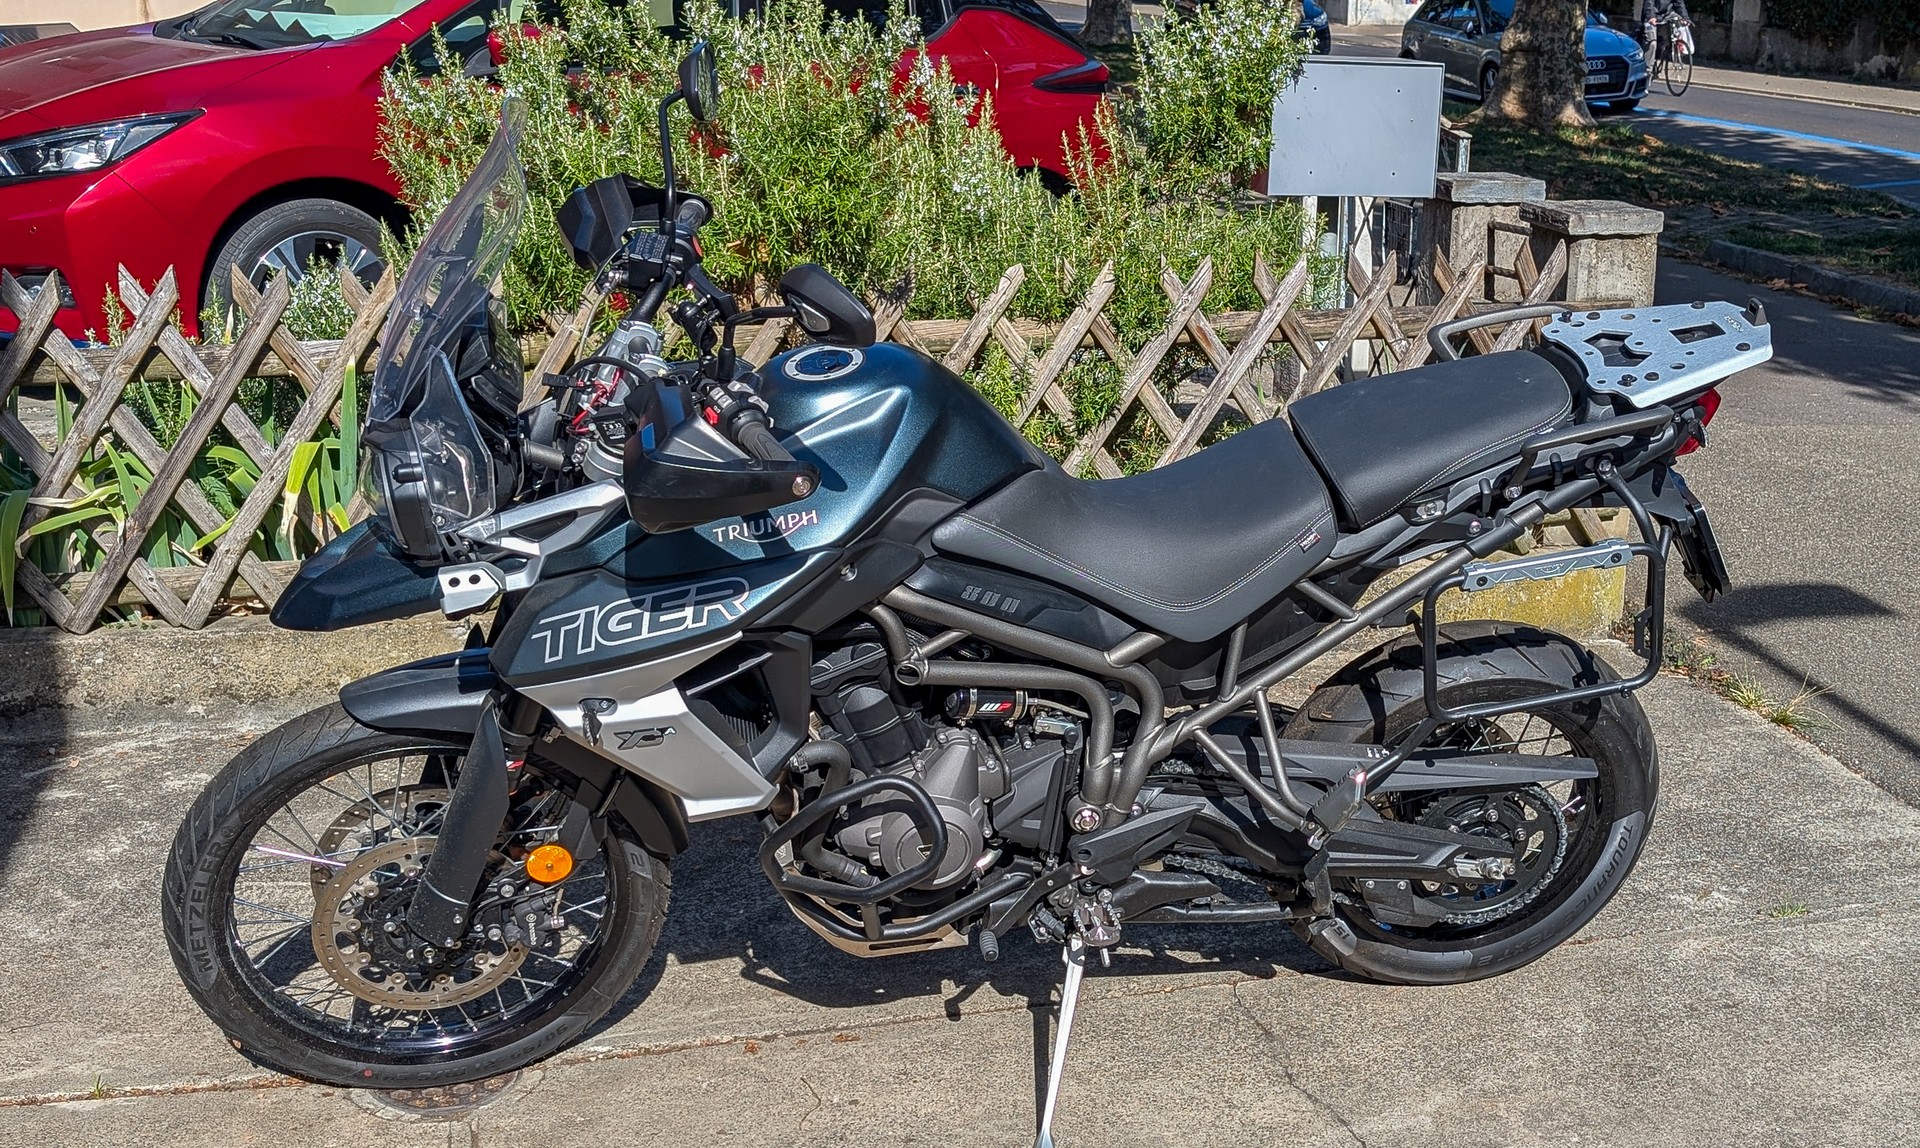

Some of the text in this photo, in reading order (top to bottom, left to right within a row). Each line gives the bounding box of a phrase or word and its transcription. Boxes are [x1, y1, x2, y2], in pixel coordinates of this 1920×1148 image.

[712, 510, 818, 543] TRIUMPH
[531, 577, 750, 663] TIGER
[961, 585, 1021, 613] 800
[188, 841, 226, 973] METZELER
[1564, 824, 1634, 926] TOURANCE
